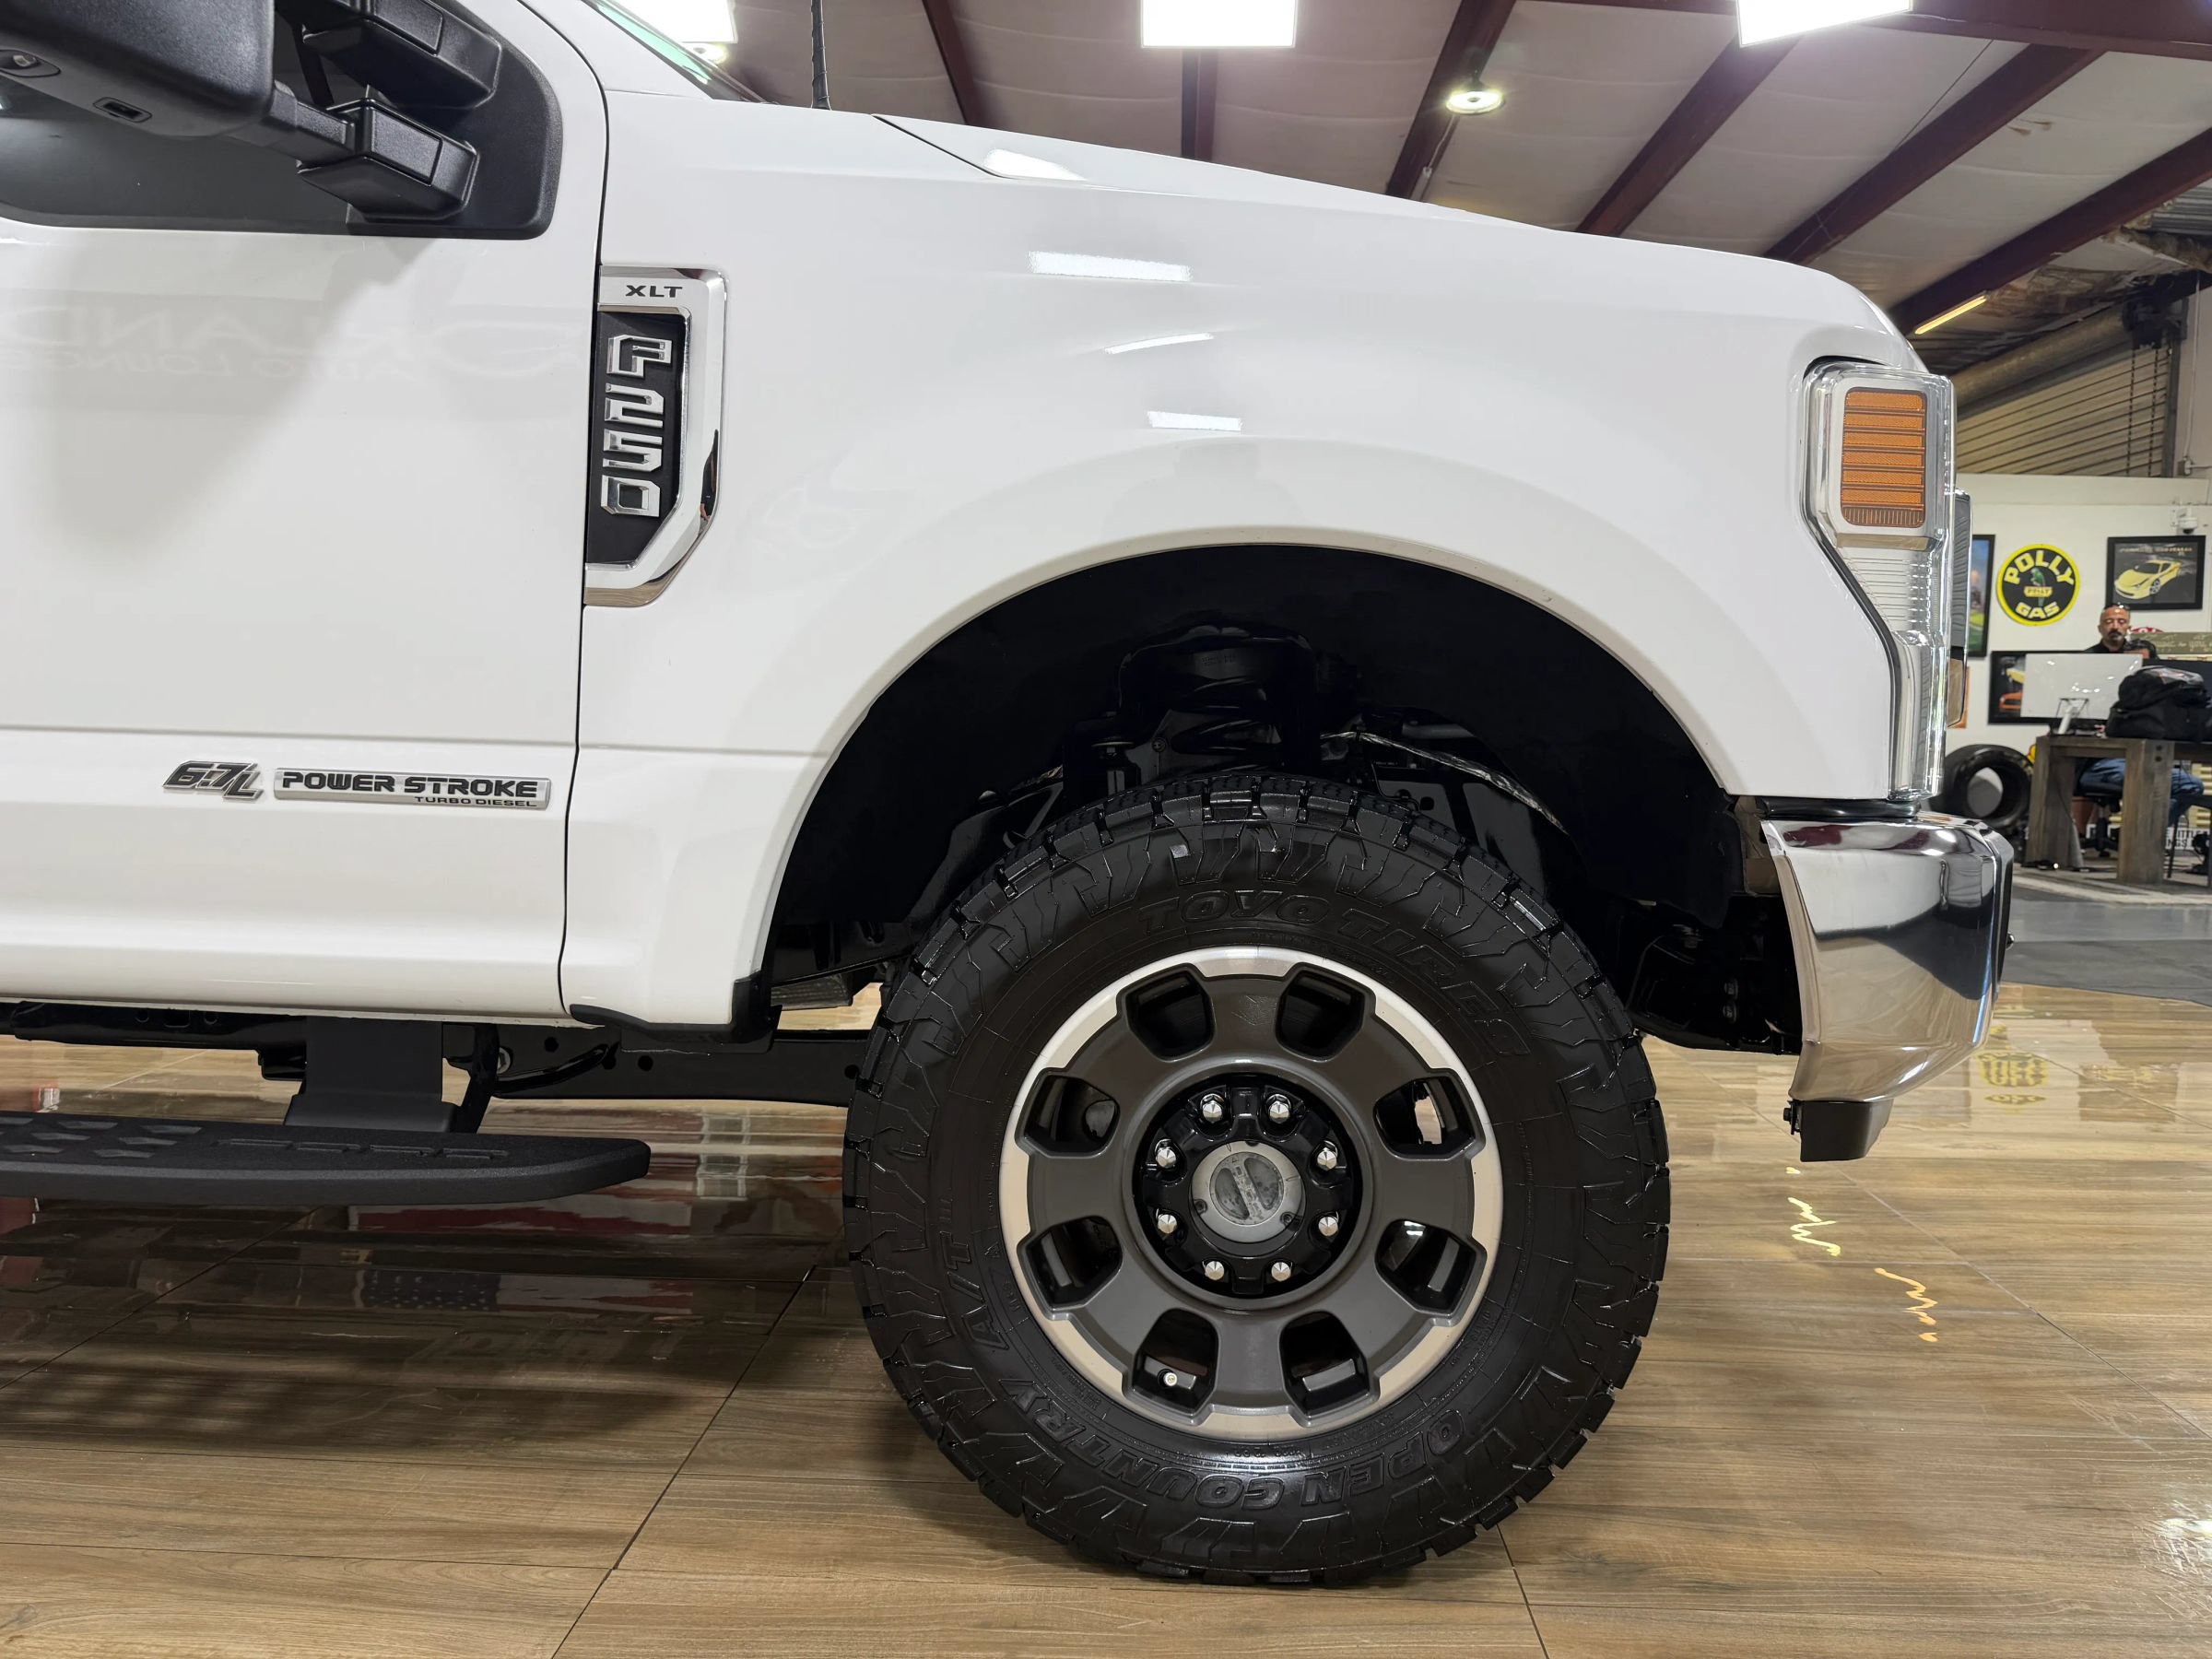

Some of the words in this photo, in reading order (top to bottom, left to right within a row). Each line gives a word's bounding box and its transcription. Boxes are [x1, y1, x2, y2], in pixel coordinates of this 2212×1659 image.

[625, 285, 683, 299] XLT
[600, 334, 673, 518] F250
[2004, 550, 2075, 586] POLLY
[2015, 601, 2060, 619] GAS
[162, 759, 264, 801] 6.7L
[281, 771, 395, 794] POWER
[404, 776, 538, 798] STROKE
[415, 795, 472, 806] TURBO
[475, 798, 537, 808] DIESEL
[1141, 889, 1328, 933] TOYO
[1341, 906, 1534, 1058] TIRES
[939, 1230, 1009, 1350] A/T
[1000, 1373, 1286, 1512] COUNTRY
[1305, 1407, 1477, 1504] OPEN
